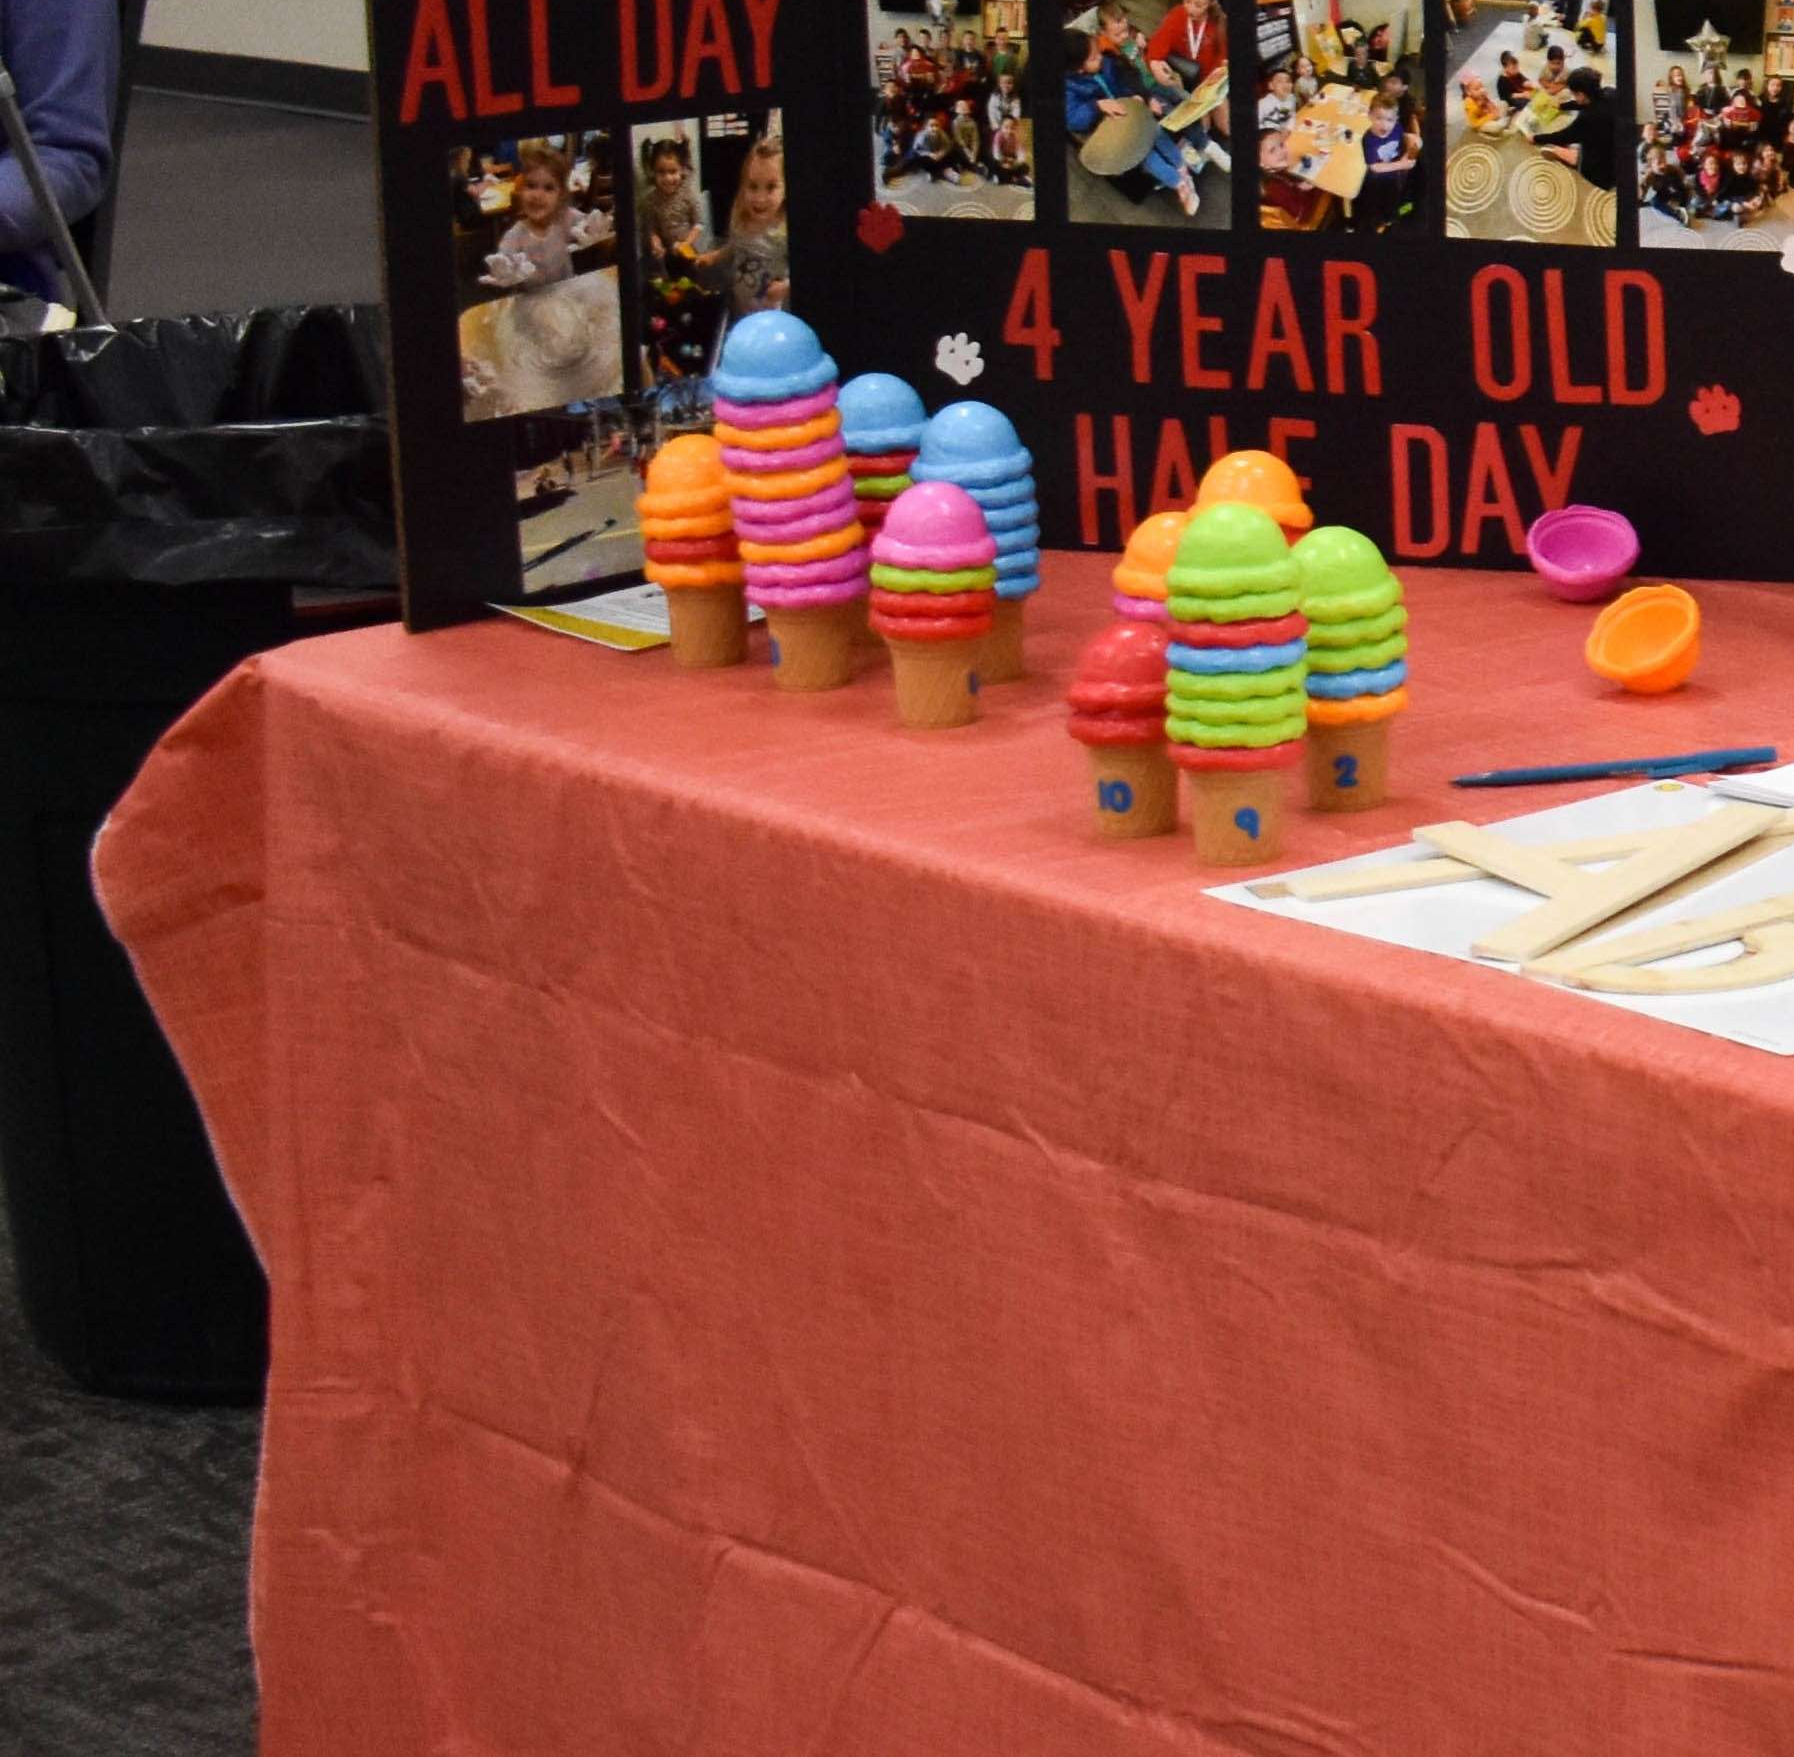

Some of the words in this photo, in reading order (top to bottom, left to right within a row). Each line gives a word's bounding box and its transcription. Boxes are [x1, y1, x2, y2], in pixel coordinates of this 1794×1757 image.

[1004, 248, 1062, 381] 4
[1109, 249, 1383, 396] YEAR
[1470, 264, 1668, 406] OLD
[1390, 422, 1584, 559] DAY
[1333, 755, 1358, 788] 2
[1096, 779, 1133, 812] 10
[1234, 807, 1260, 838] 9
